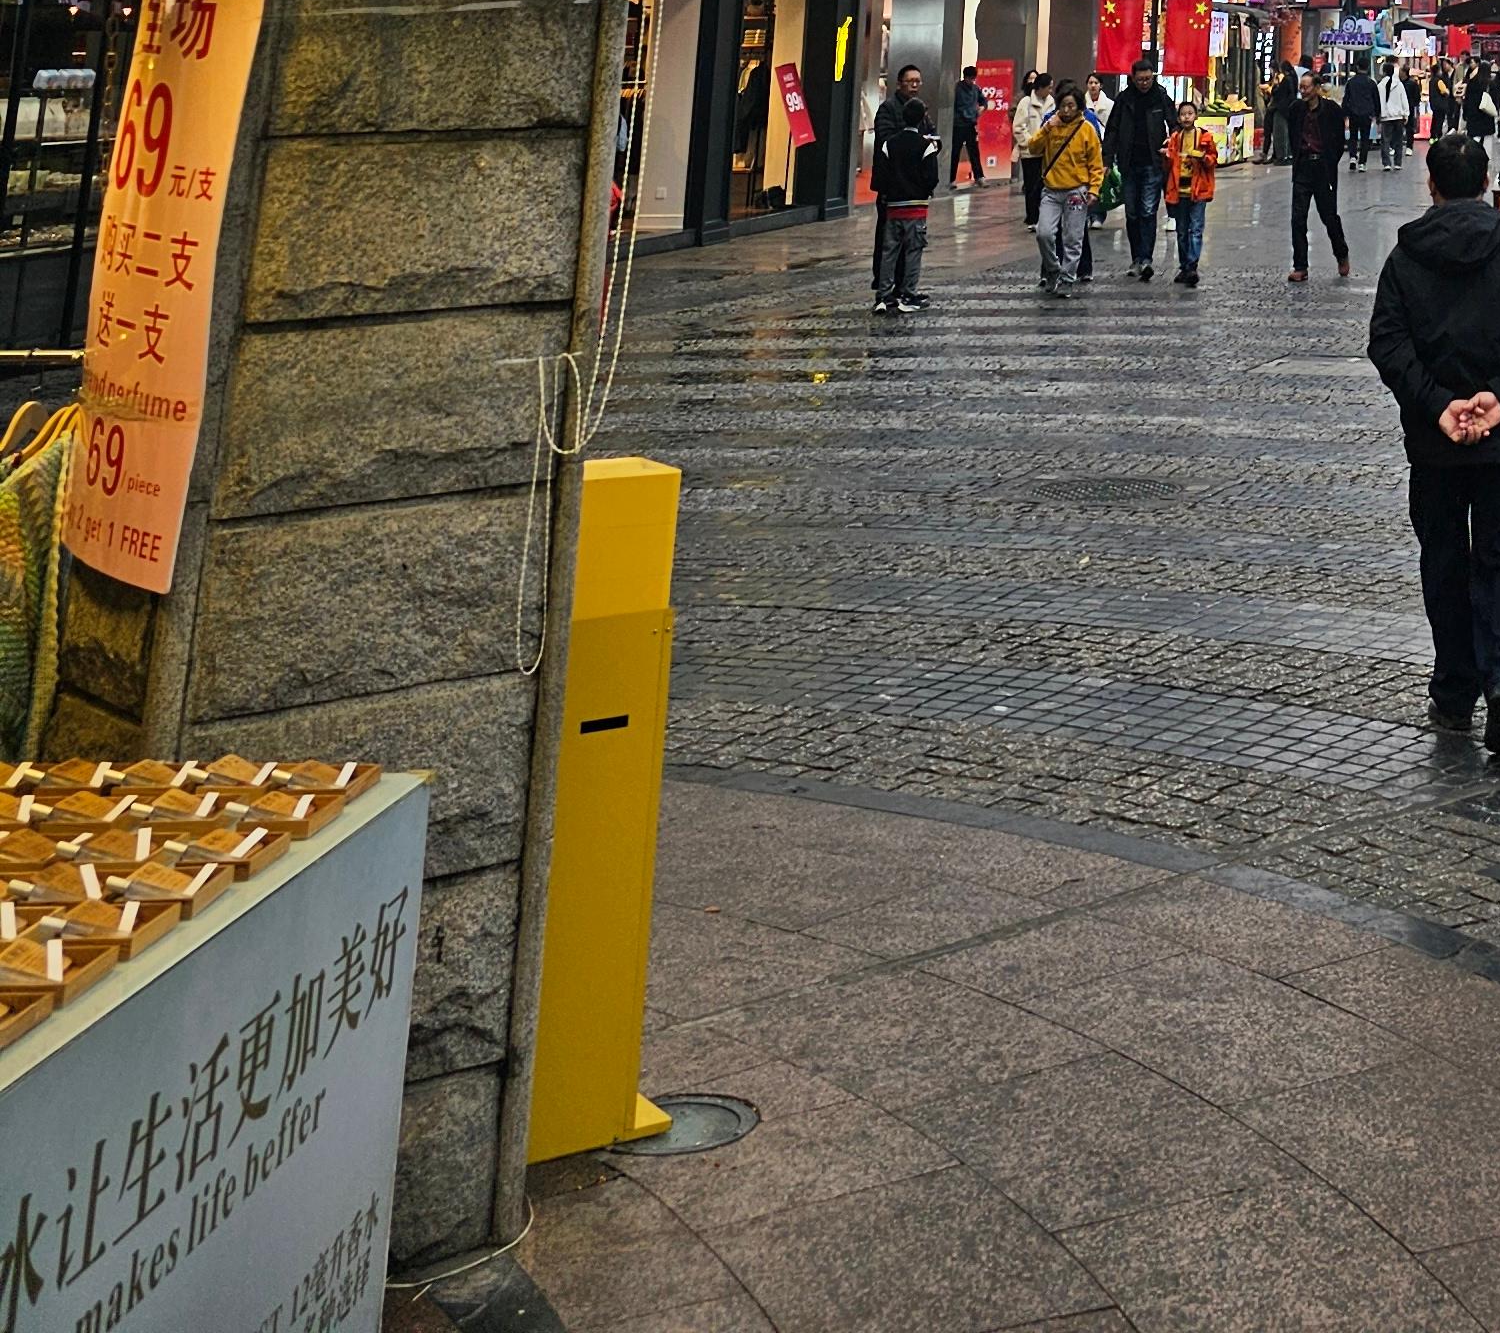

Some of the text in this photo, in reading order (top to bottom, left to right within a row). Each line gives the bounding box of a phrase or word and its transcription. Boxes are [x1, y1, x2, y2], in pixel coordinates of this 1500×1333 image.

[100, 214, 199, 292] 购买二支
[95, 291, 170, 365] 送一支
[86, 416, 125, 497] 69
[119, 527, 162, 563] FREE
[186, 1161, 237, 1257] life
